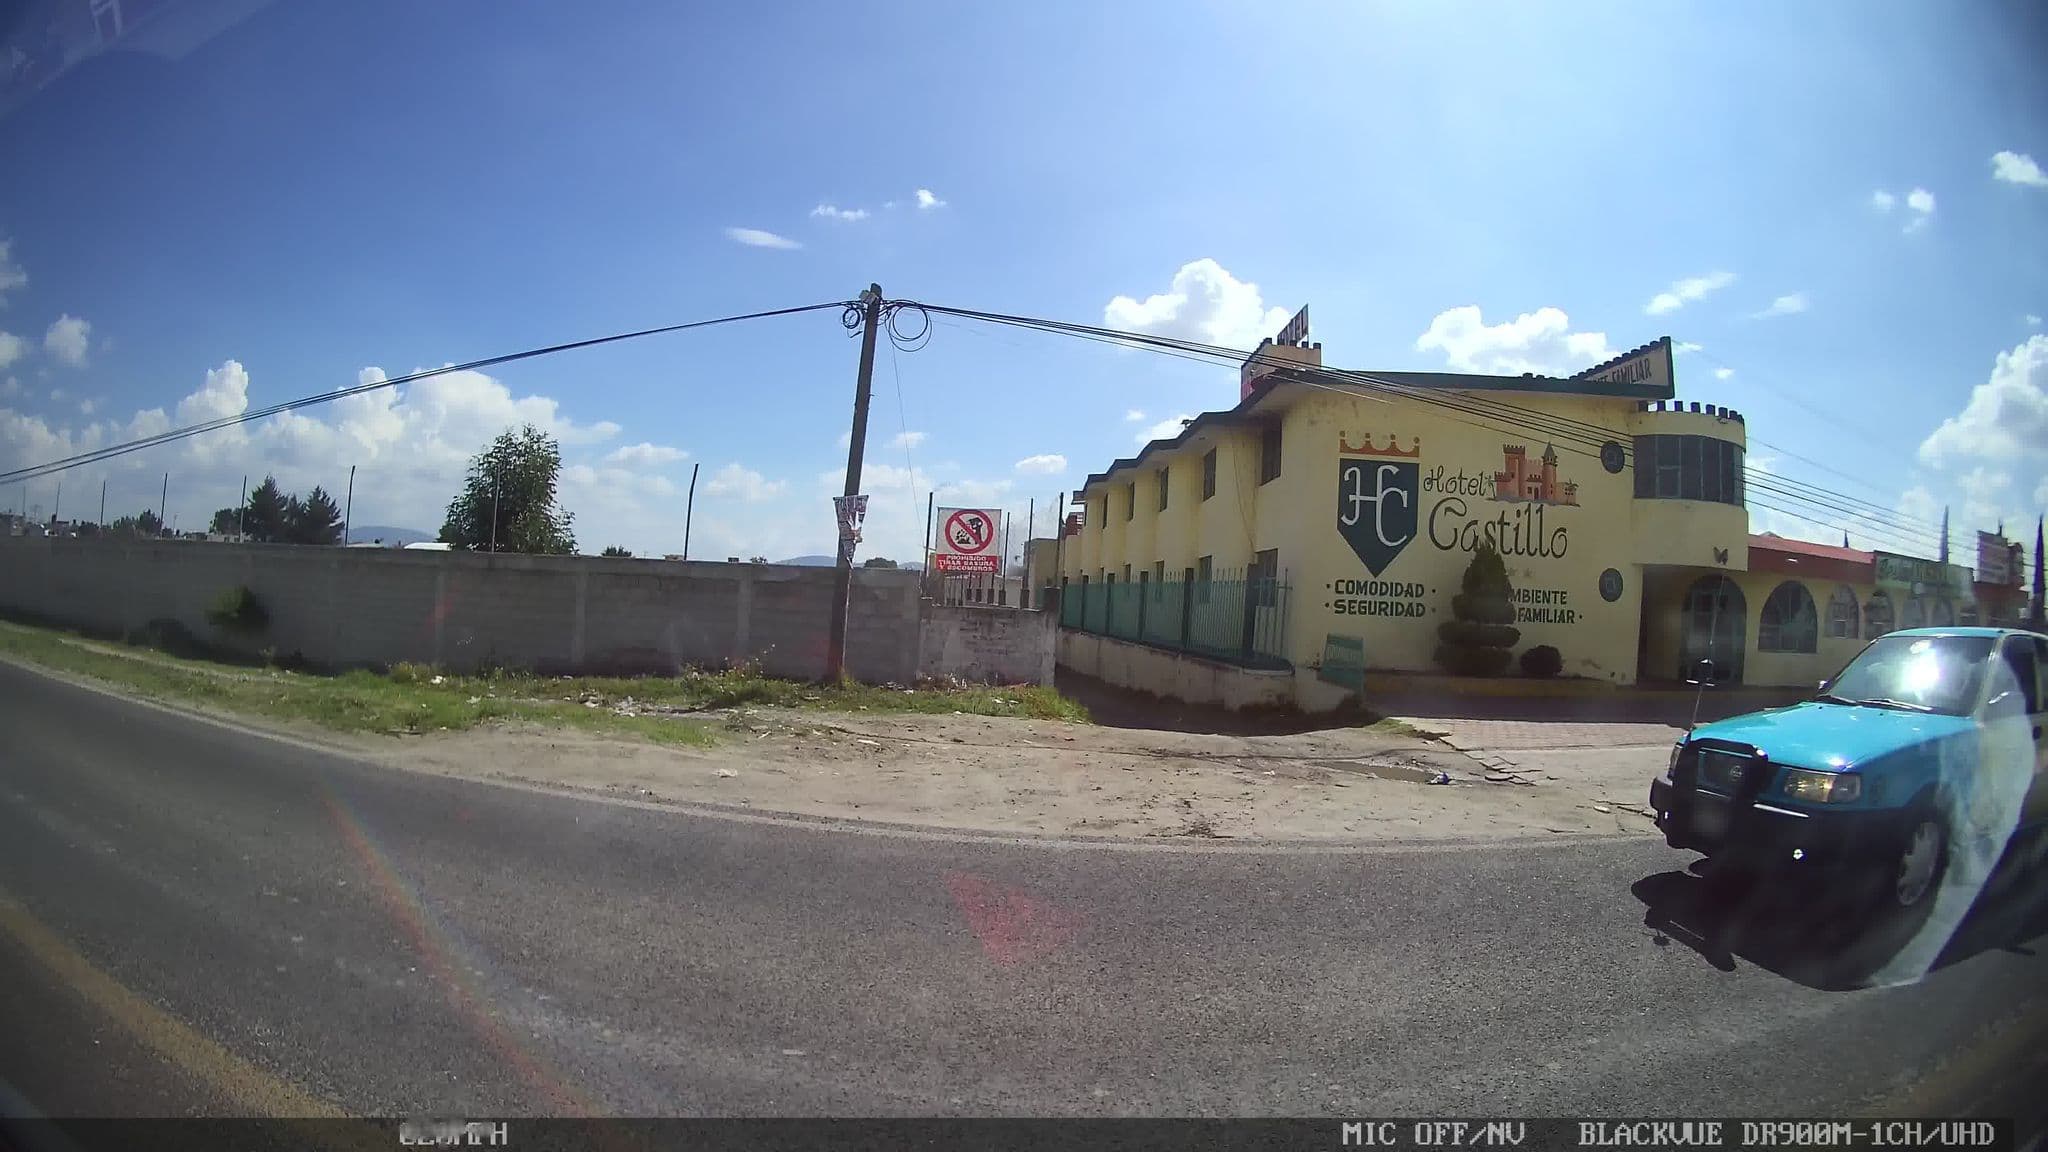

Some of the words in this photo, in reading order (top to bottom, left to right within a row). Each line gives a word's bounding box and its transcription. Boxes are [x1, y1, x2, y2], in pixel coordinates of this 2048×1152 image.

[1612, 359, 1652, 384] FAMILIAR
[1423, 465, 1487, 497] Hotel
[1428, 497, 1567, 559] Castillo
[1334, 579, 1424, 598] COMODIDAD
[1510, 588, 1568, 605] MBIENTE
[1333, 599, 1426, 618] SEGURIDAD
[1517, 607, 1575, 624] FAMILIAR
